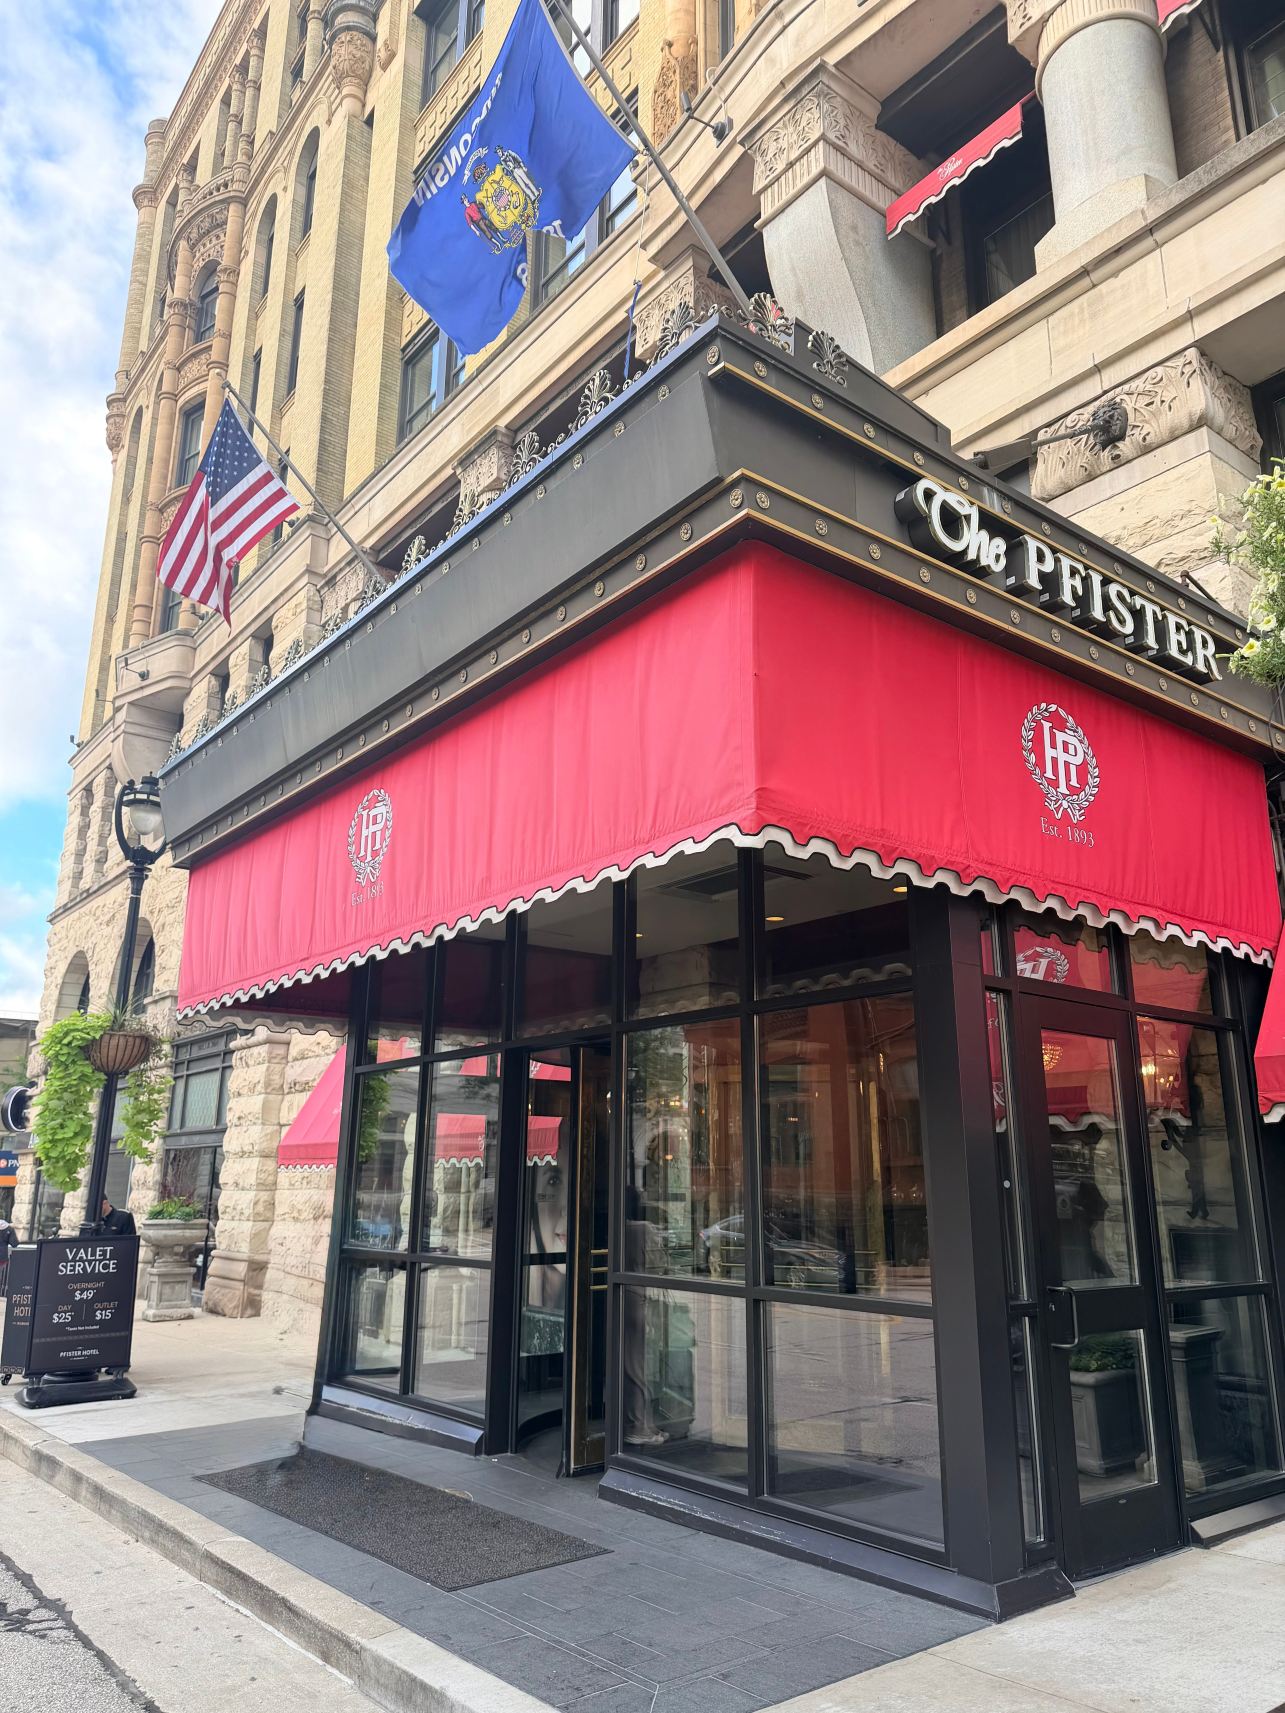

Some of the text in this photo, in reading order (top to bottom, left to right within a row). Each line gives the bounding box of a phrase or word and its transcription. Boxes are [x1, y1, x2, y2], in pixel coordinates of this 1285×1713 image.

[912, 477, 1223, 682] The PFISTER
[1040, 816, 1094, 848] Est. 1893
[8, 1159, 20, 1168] PN
[65, 1246, 114, 1260] VALET
[58, 1260, 117, 1275] SERVICE
[67, 1281, 105, 1290] OVERNIGHT
[12, 1294, 32, 1304] PFIST
[58, 1304, 72, 1312] DAY
[93, 1301, 118, 1309] OUTLET
[13, 1306, 31, 1317] HOT
[59, 1349, 81, 1358] PFISTER
[82, 1348, 100, 1356] HOTEL
